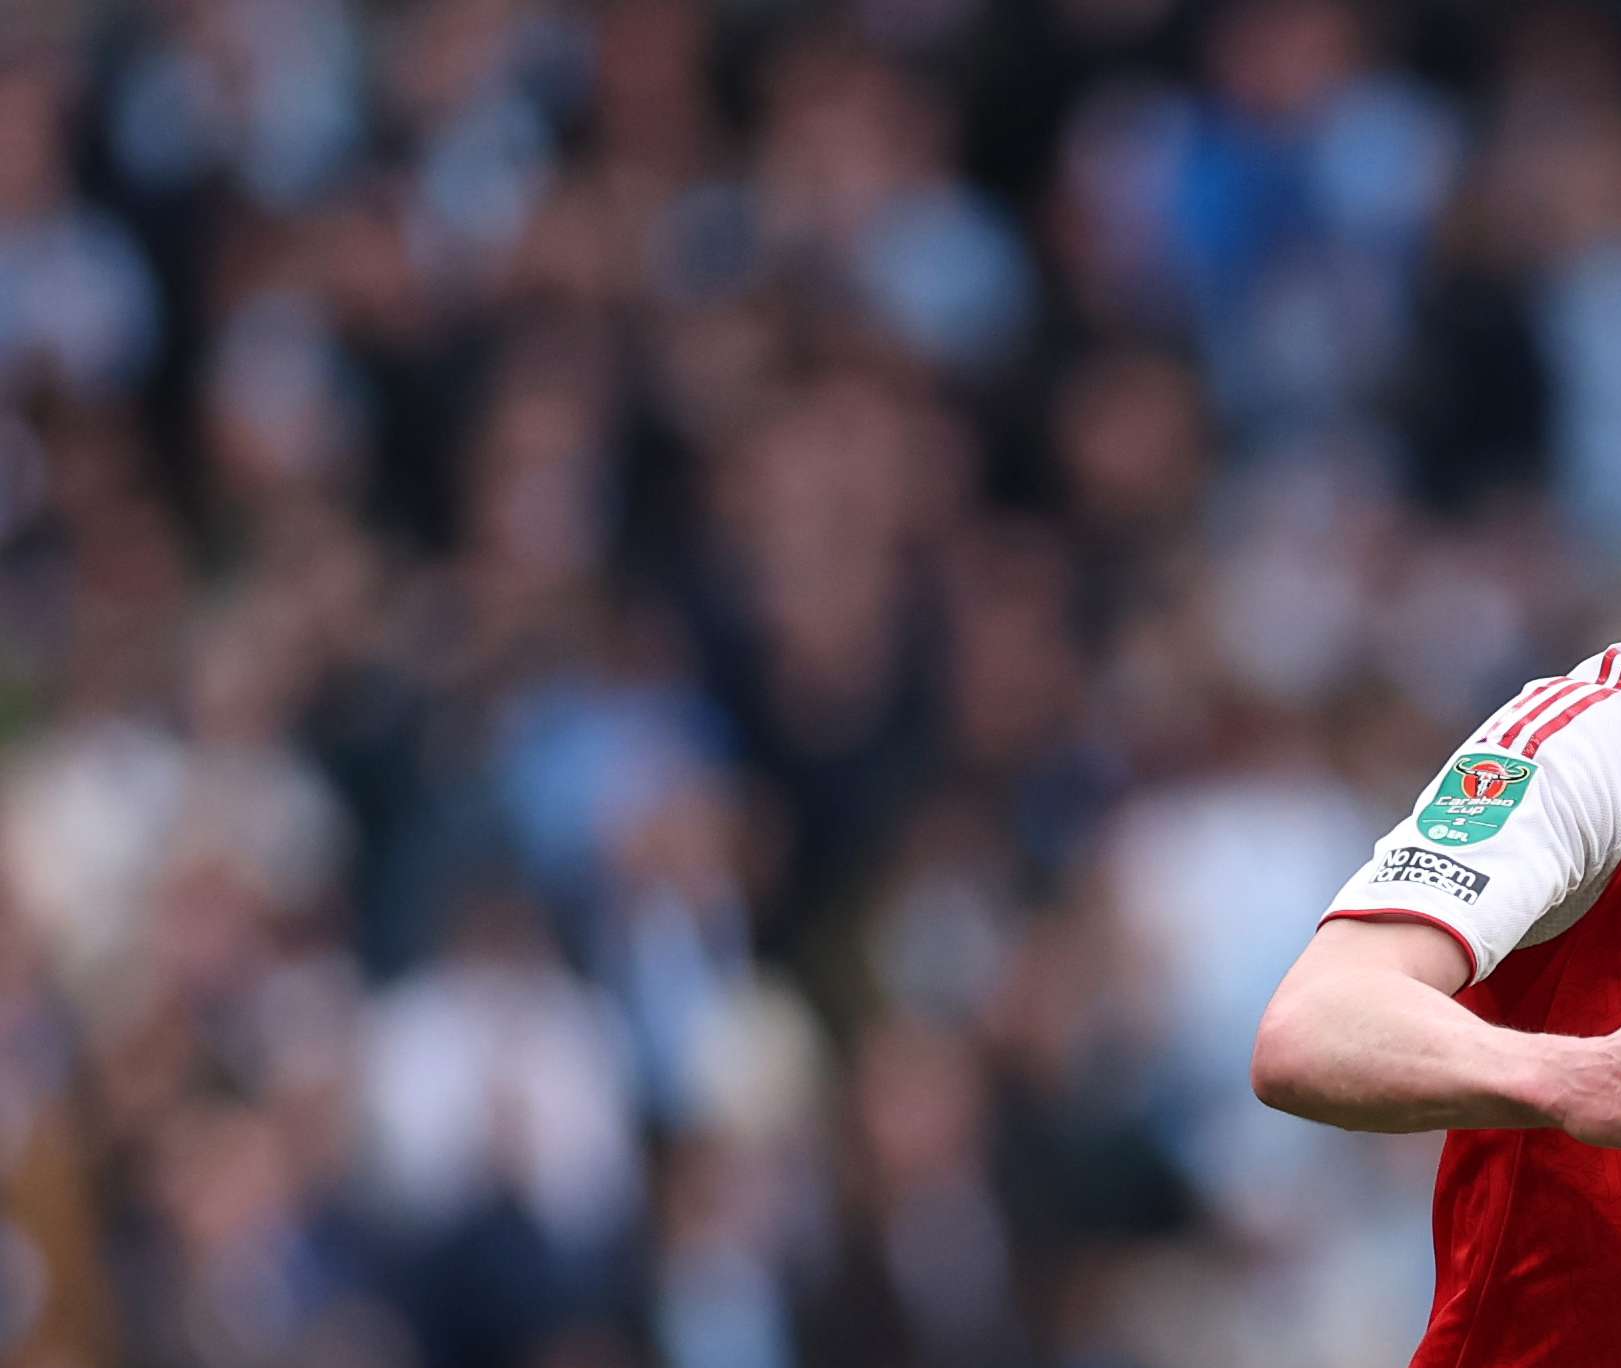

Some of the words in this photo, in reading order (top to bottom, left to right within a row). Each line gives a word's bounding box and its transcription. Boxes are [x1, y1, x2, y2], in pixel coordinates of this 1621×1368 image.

[1447, 805, 1485, 816] Cup
[1383, 849, 1410, 867] No
[1410, 851, 1476, 888] room
[1402, 867, 1478, 905] racism
